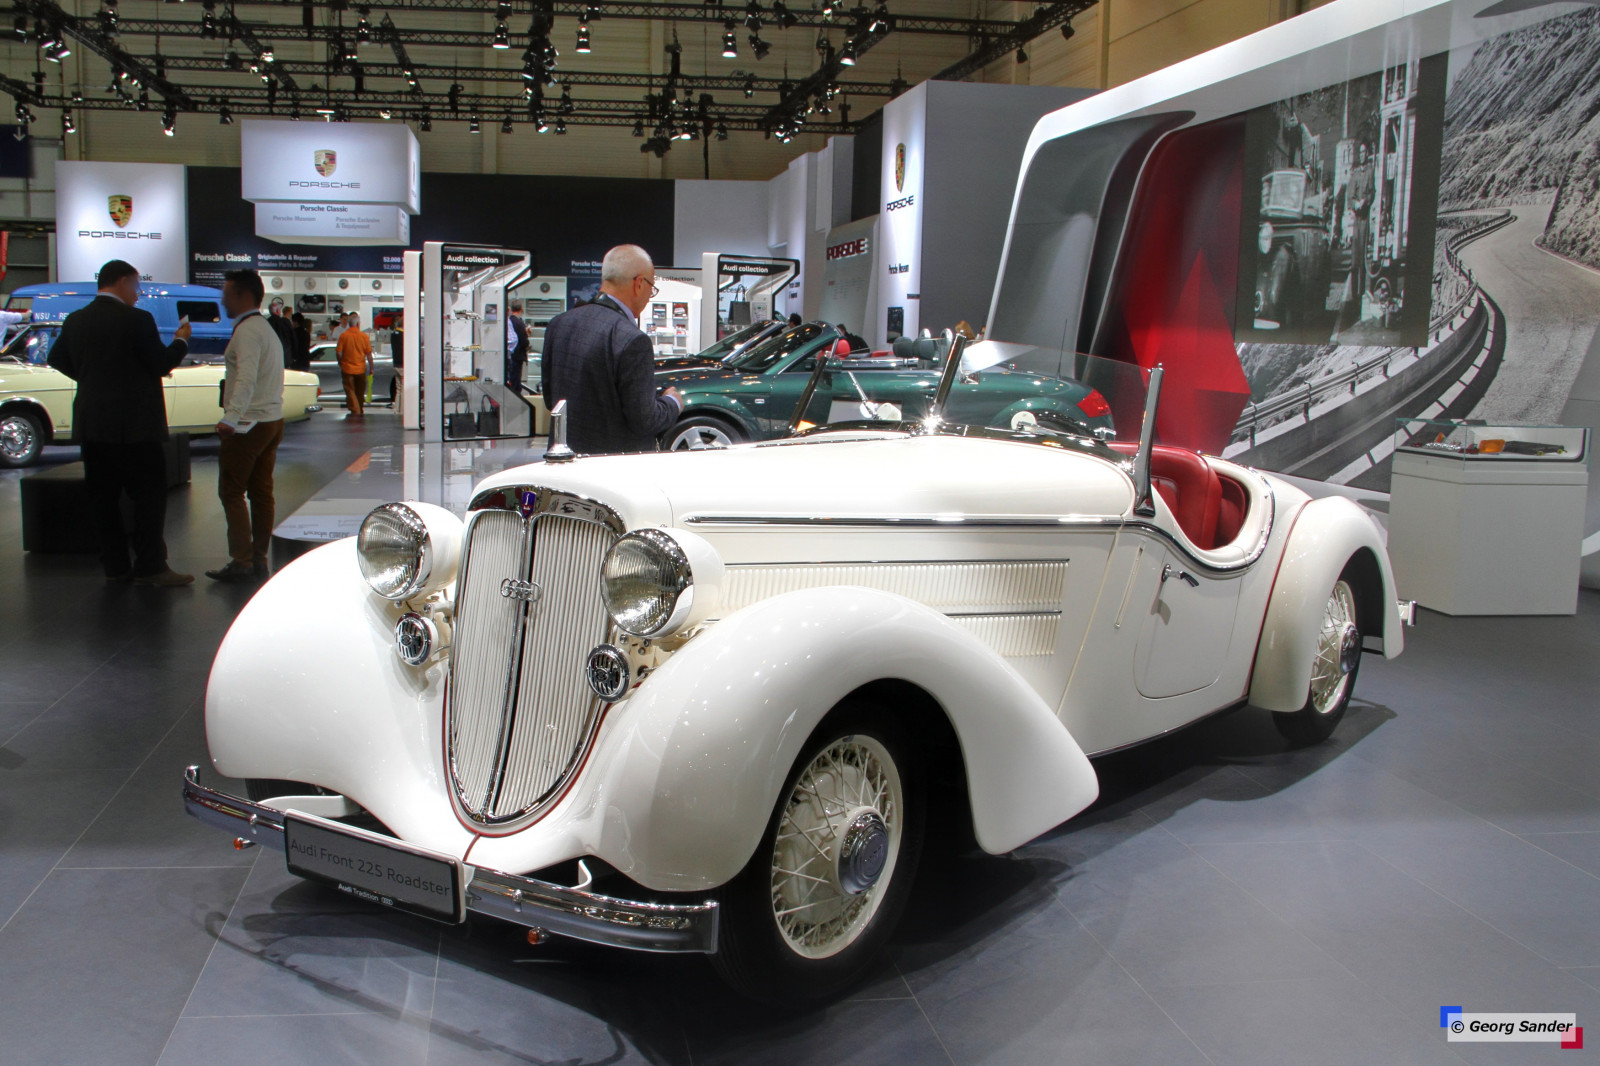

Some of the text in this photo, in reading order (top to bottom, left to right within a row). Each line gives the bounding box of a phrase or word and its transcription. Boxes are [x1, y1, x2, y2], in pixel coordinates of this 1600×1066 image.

[289, 181, 361, 189] PORSCHE
[885, 195, 914, 212] PORSCHE
[78, 230, 162, 239] PORSCHE
[826, 238, 868, 261] PORSCHE
[194, 253, 252, 262] Porsche Classic
[446, 254, 499, 264] Audi collection
[35, 312, 50, 320] NSU
[290, 838, 451, 897] Audi Front 225 Roadster
[338, 883, 379, 901] Audi Tradition
